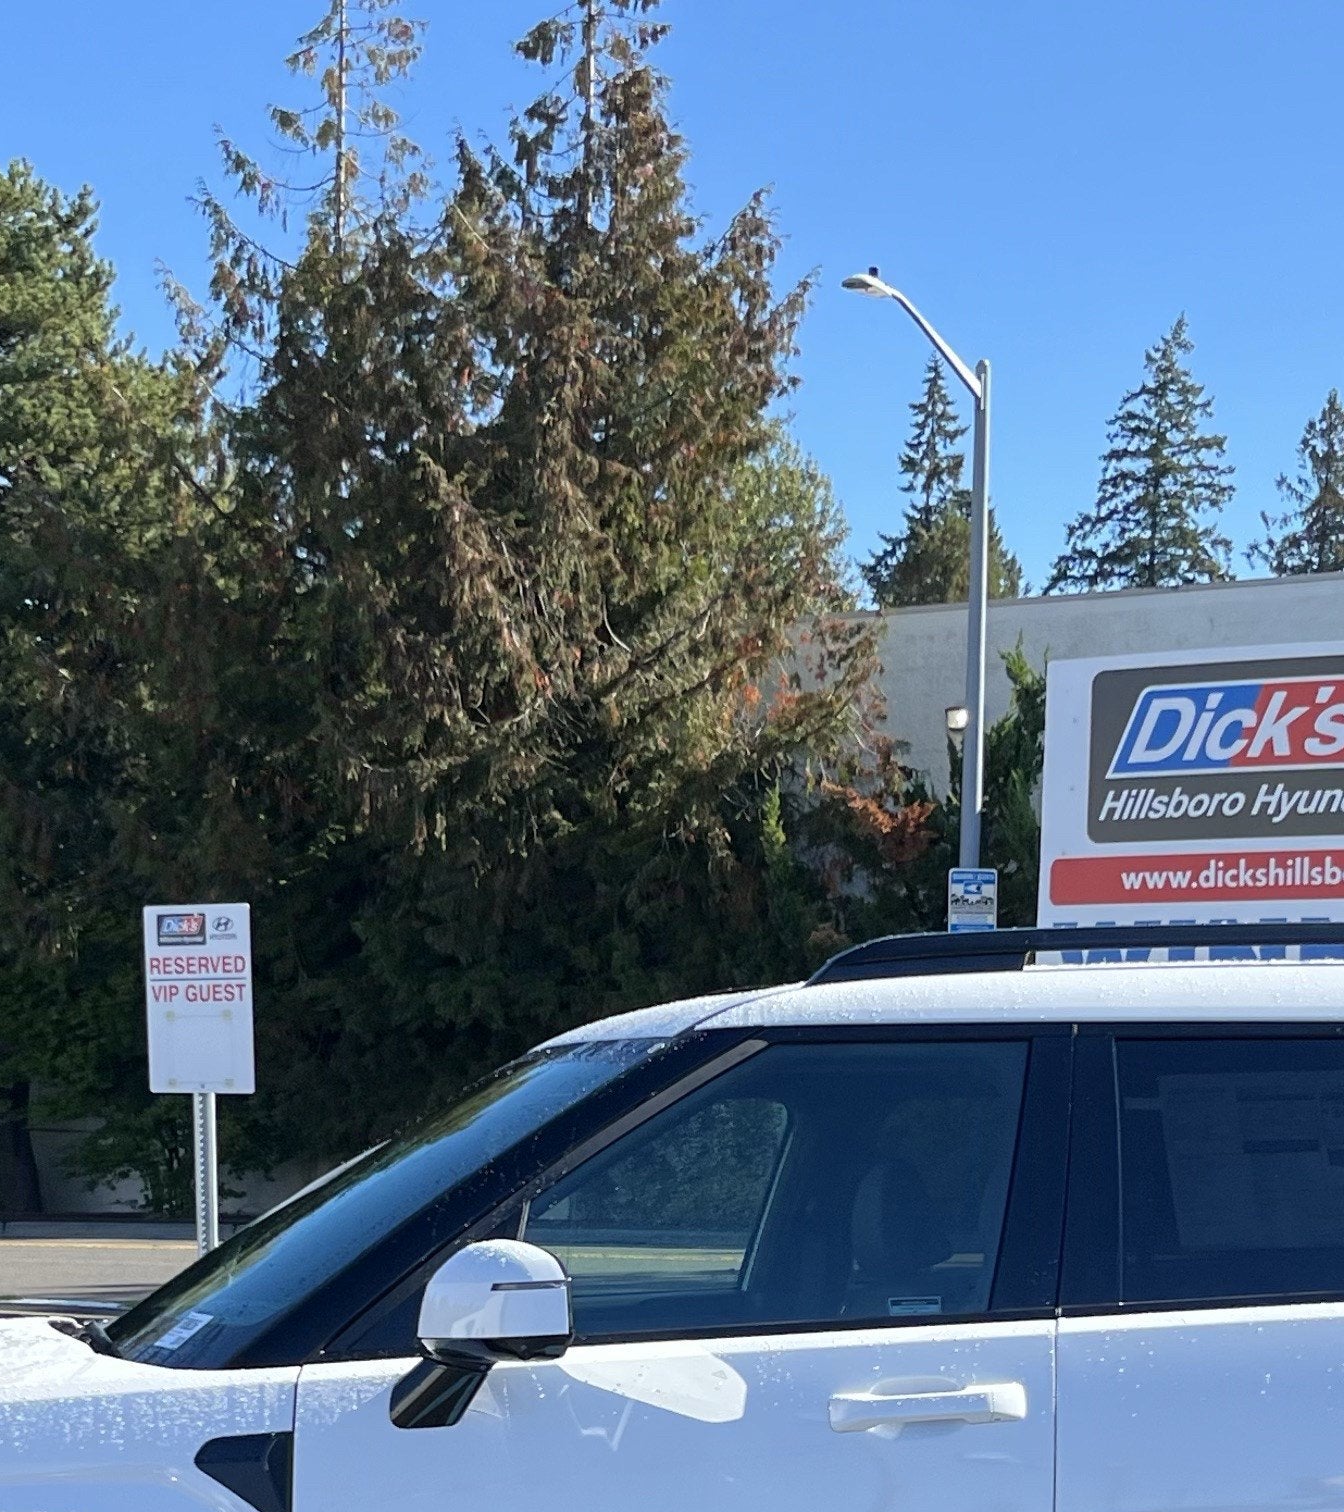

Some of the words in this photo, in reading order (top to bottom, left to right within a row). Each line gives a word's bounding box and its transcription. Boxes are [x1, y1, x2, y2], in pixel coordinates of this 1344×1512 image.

[1098, 787, 1250, 823] Hillsboro
[149, 955, 246, 975] RESERVED
[151, 985, 179, 1003] VIP
[185, 983, 247, 1002] GUEST
